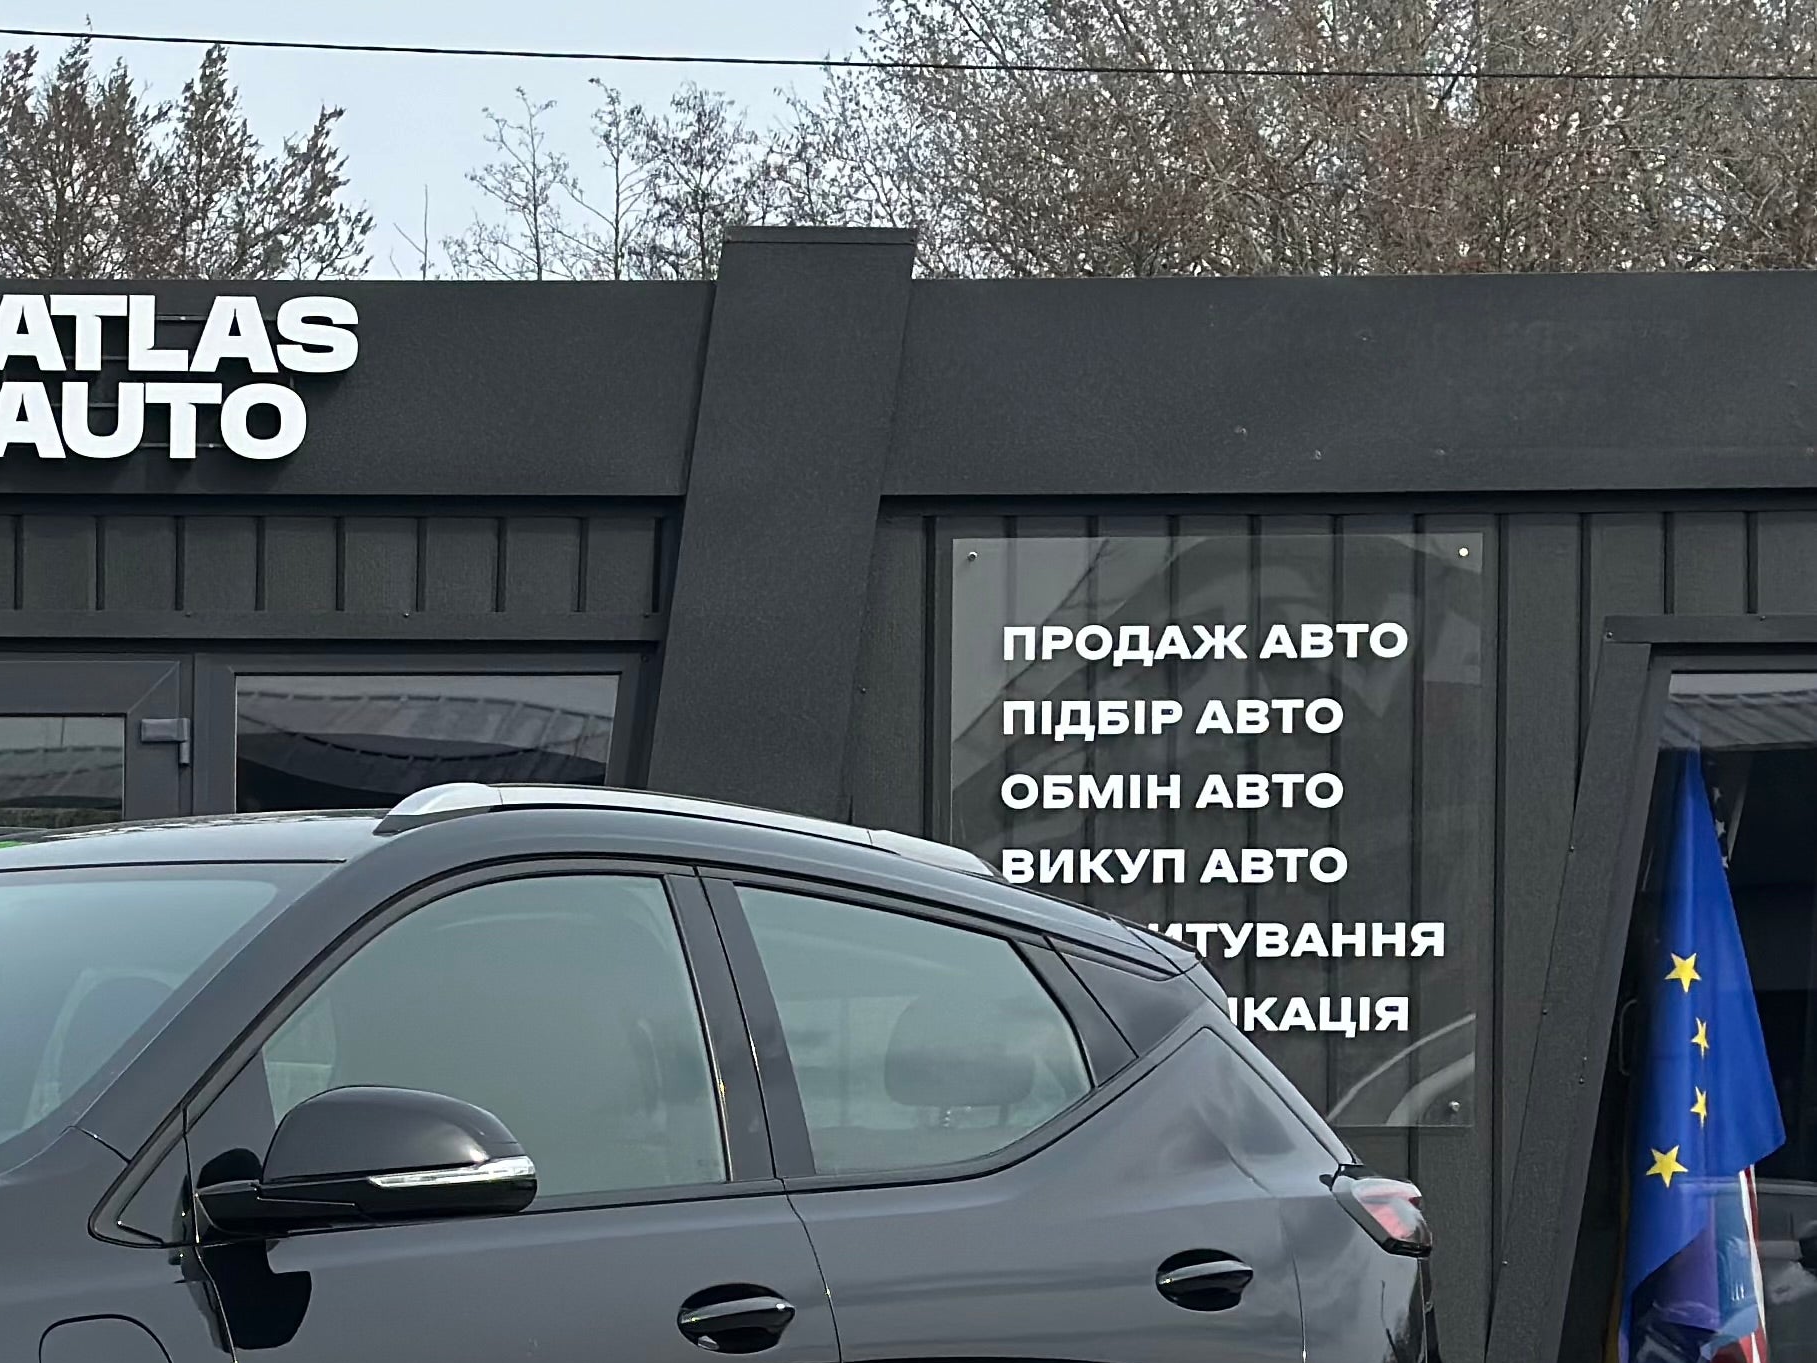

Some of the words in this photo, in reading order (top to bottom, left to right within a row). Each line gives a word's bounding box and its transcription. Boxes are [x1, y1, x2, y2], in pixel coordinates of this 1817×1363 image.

[1002, 624, 1248, 667] ПРОДАЖ
[1259, 622, 1409, 661] АВТО
[1002, 699, 1183, 742] ПІДБІР
[1195, 698, 1344, 735] АВТО
[1001, 773, 1181, 810] ОБМІН
[1195, 772, 1344, 809] АВТО
[1002, 848, 1185, 884] ВИКУП
[1199, 847, 1348, 884] АВТО
[1148, 922, 1445, 958] ТУВАННЯ
